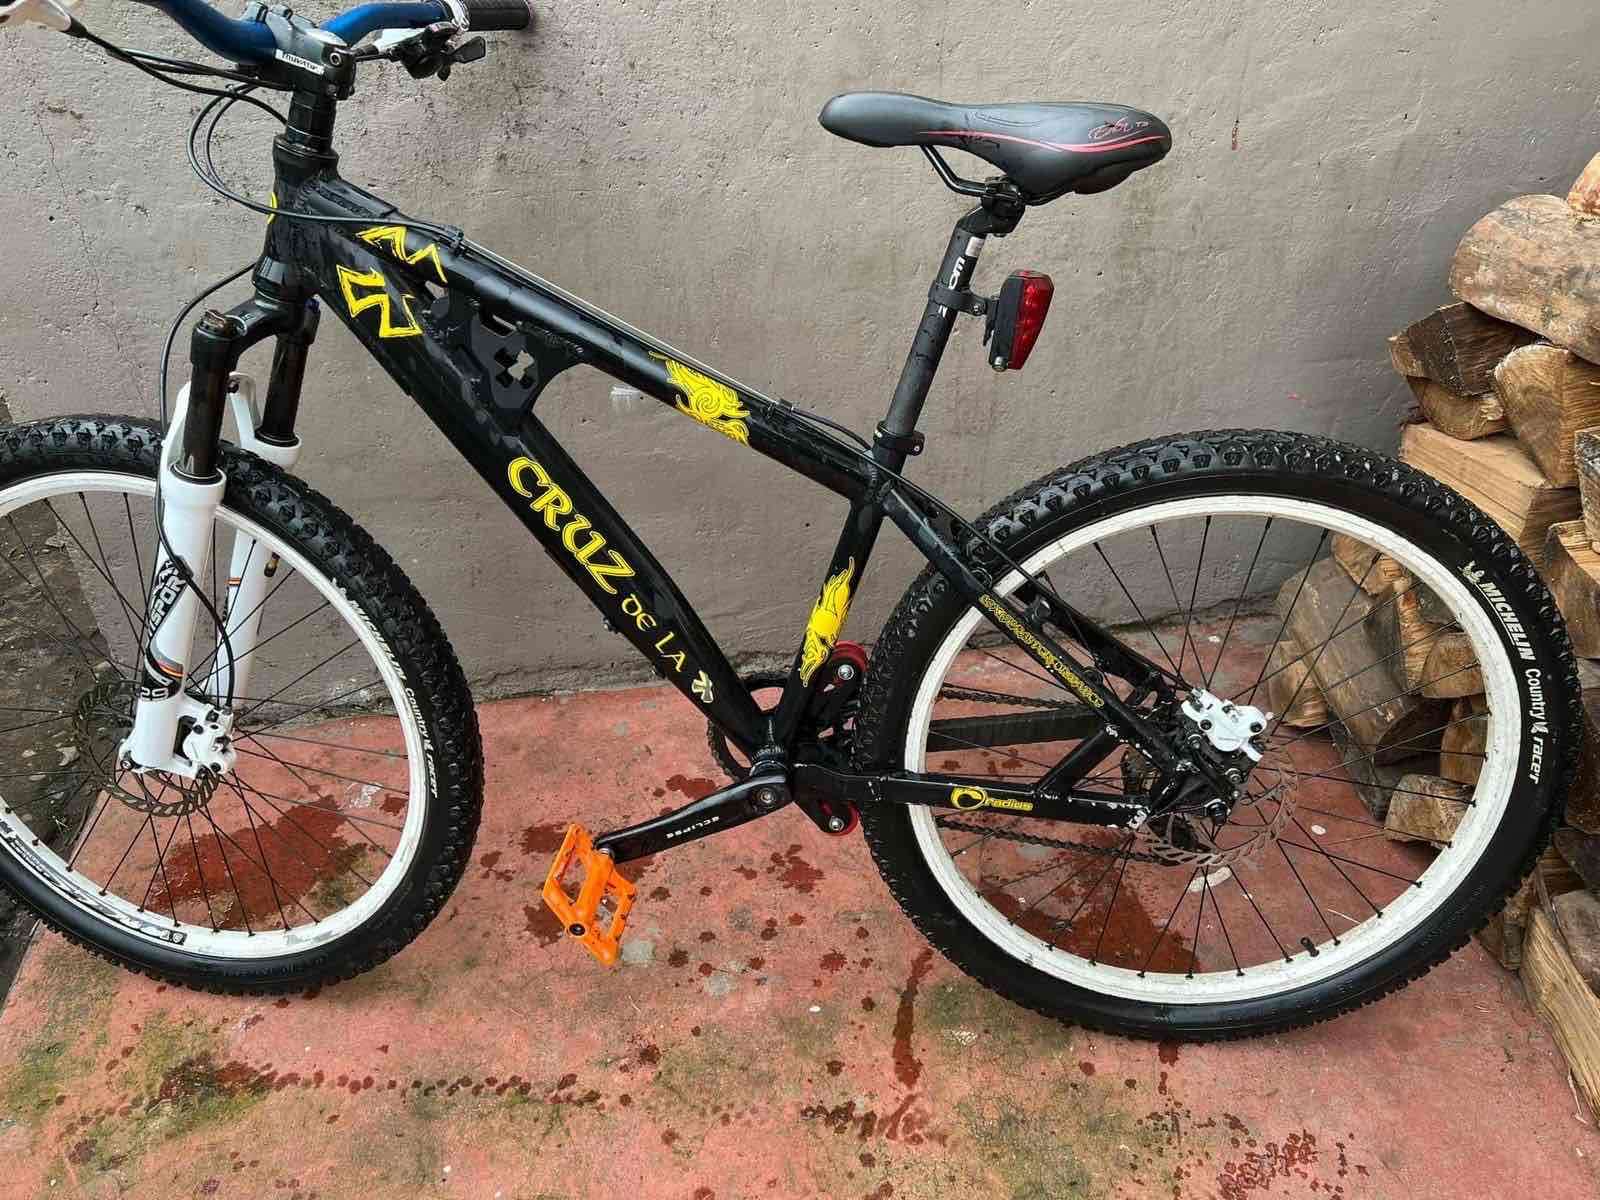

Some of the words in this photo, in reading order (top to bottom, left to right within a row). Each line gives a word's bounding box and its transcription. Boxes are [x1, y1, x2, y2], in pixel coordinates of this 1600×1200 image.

[507, 456, 636, 594] CRUZ
[621, 593, 657, 632] DE
[655, 631, 687, 673] LA
[1480, 582, 1537, 661] MICHELIN
[1525, 668, 1547, 727] Country
